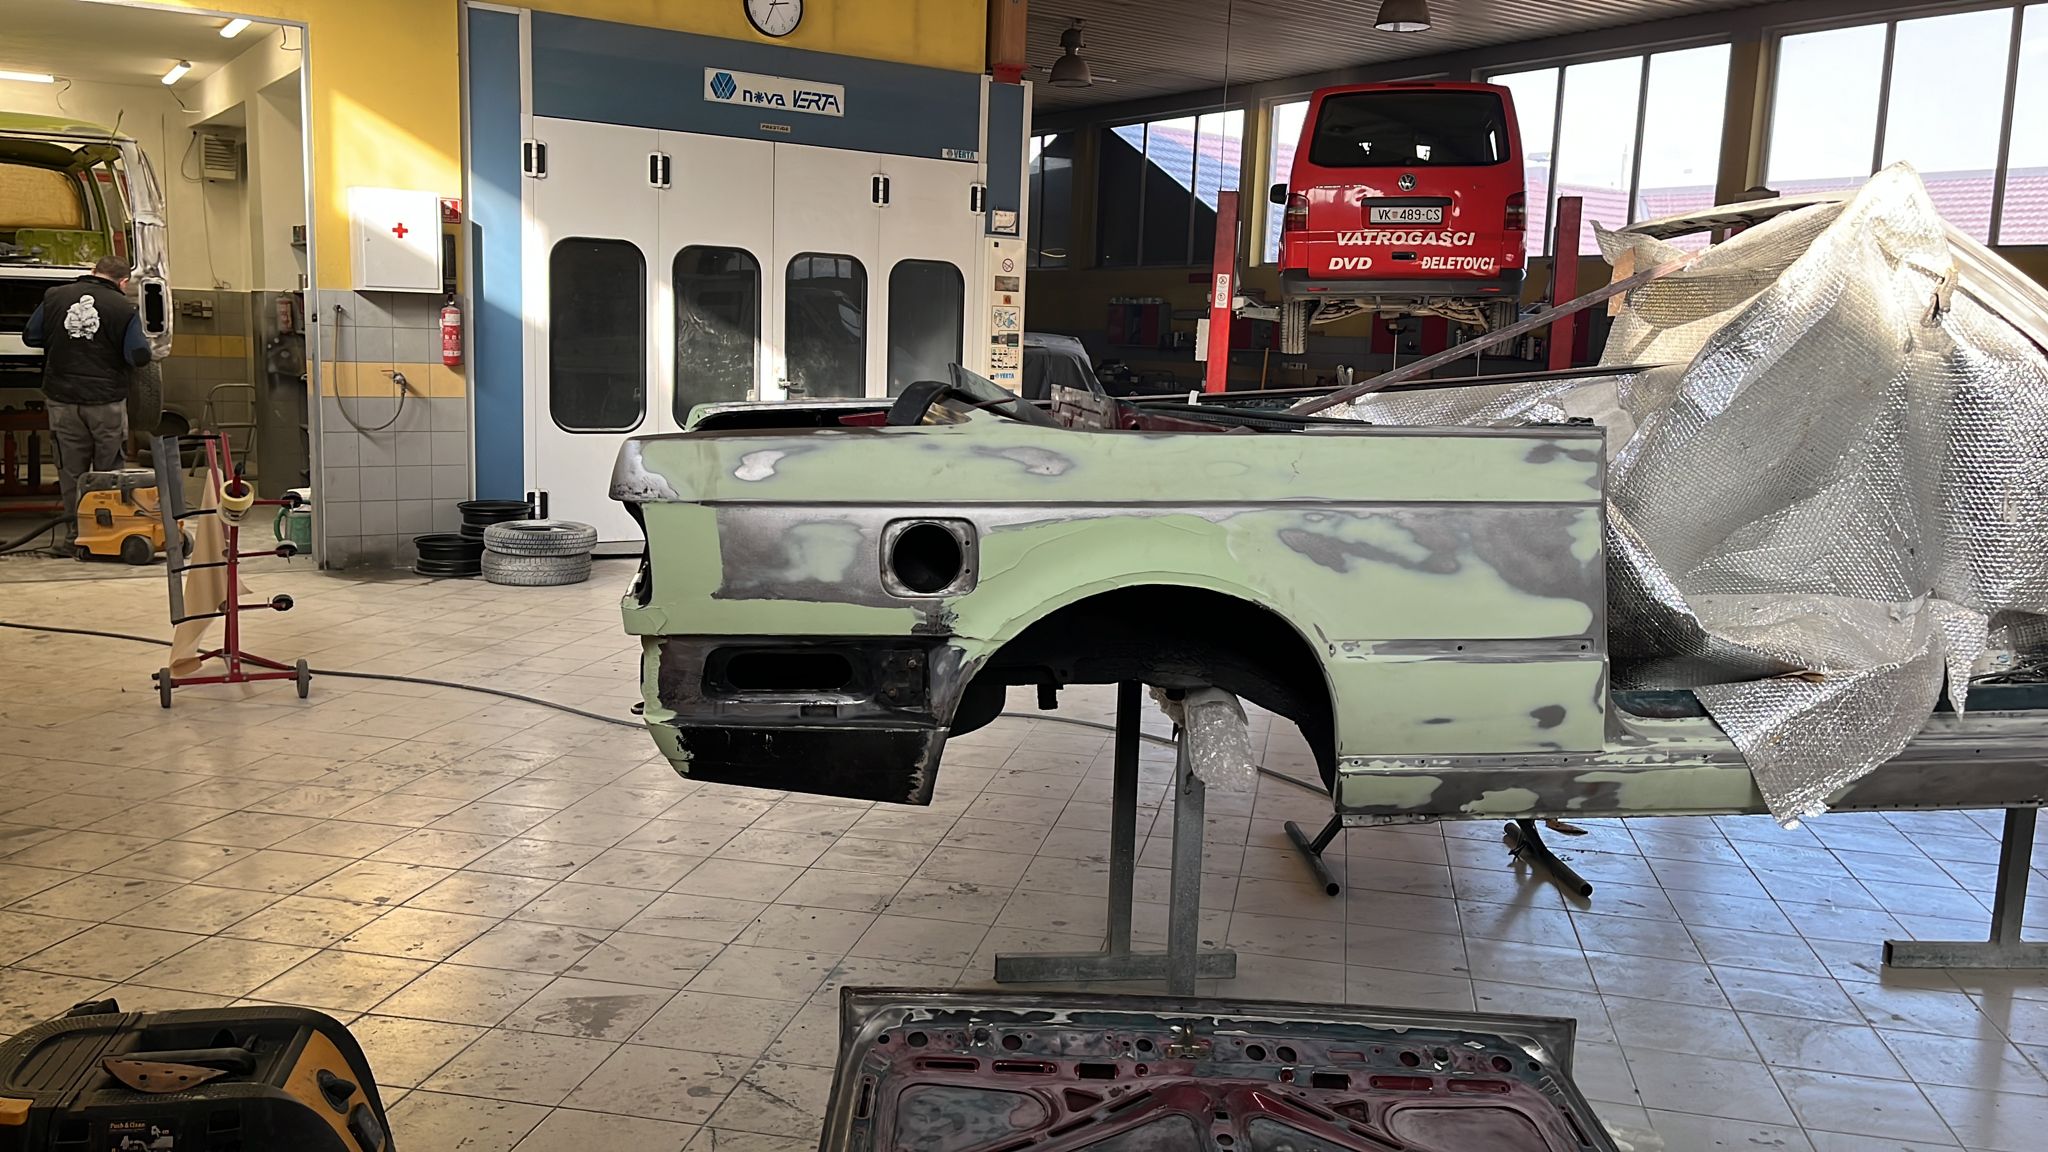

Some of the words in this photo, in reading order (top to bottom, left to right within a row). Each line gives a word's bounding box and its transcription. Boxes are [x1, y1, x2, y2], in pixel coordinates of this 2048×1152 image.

[793, 89, 841, 113] VERTA
[1378, 209, 1391, 221] VK
[1336, 232, 1475, 246] VATROGASCI
[1328, 257, 1373, 270] DVD
[1421, 256, 1495, 270] ĐELETOVCI
